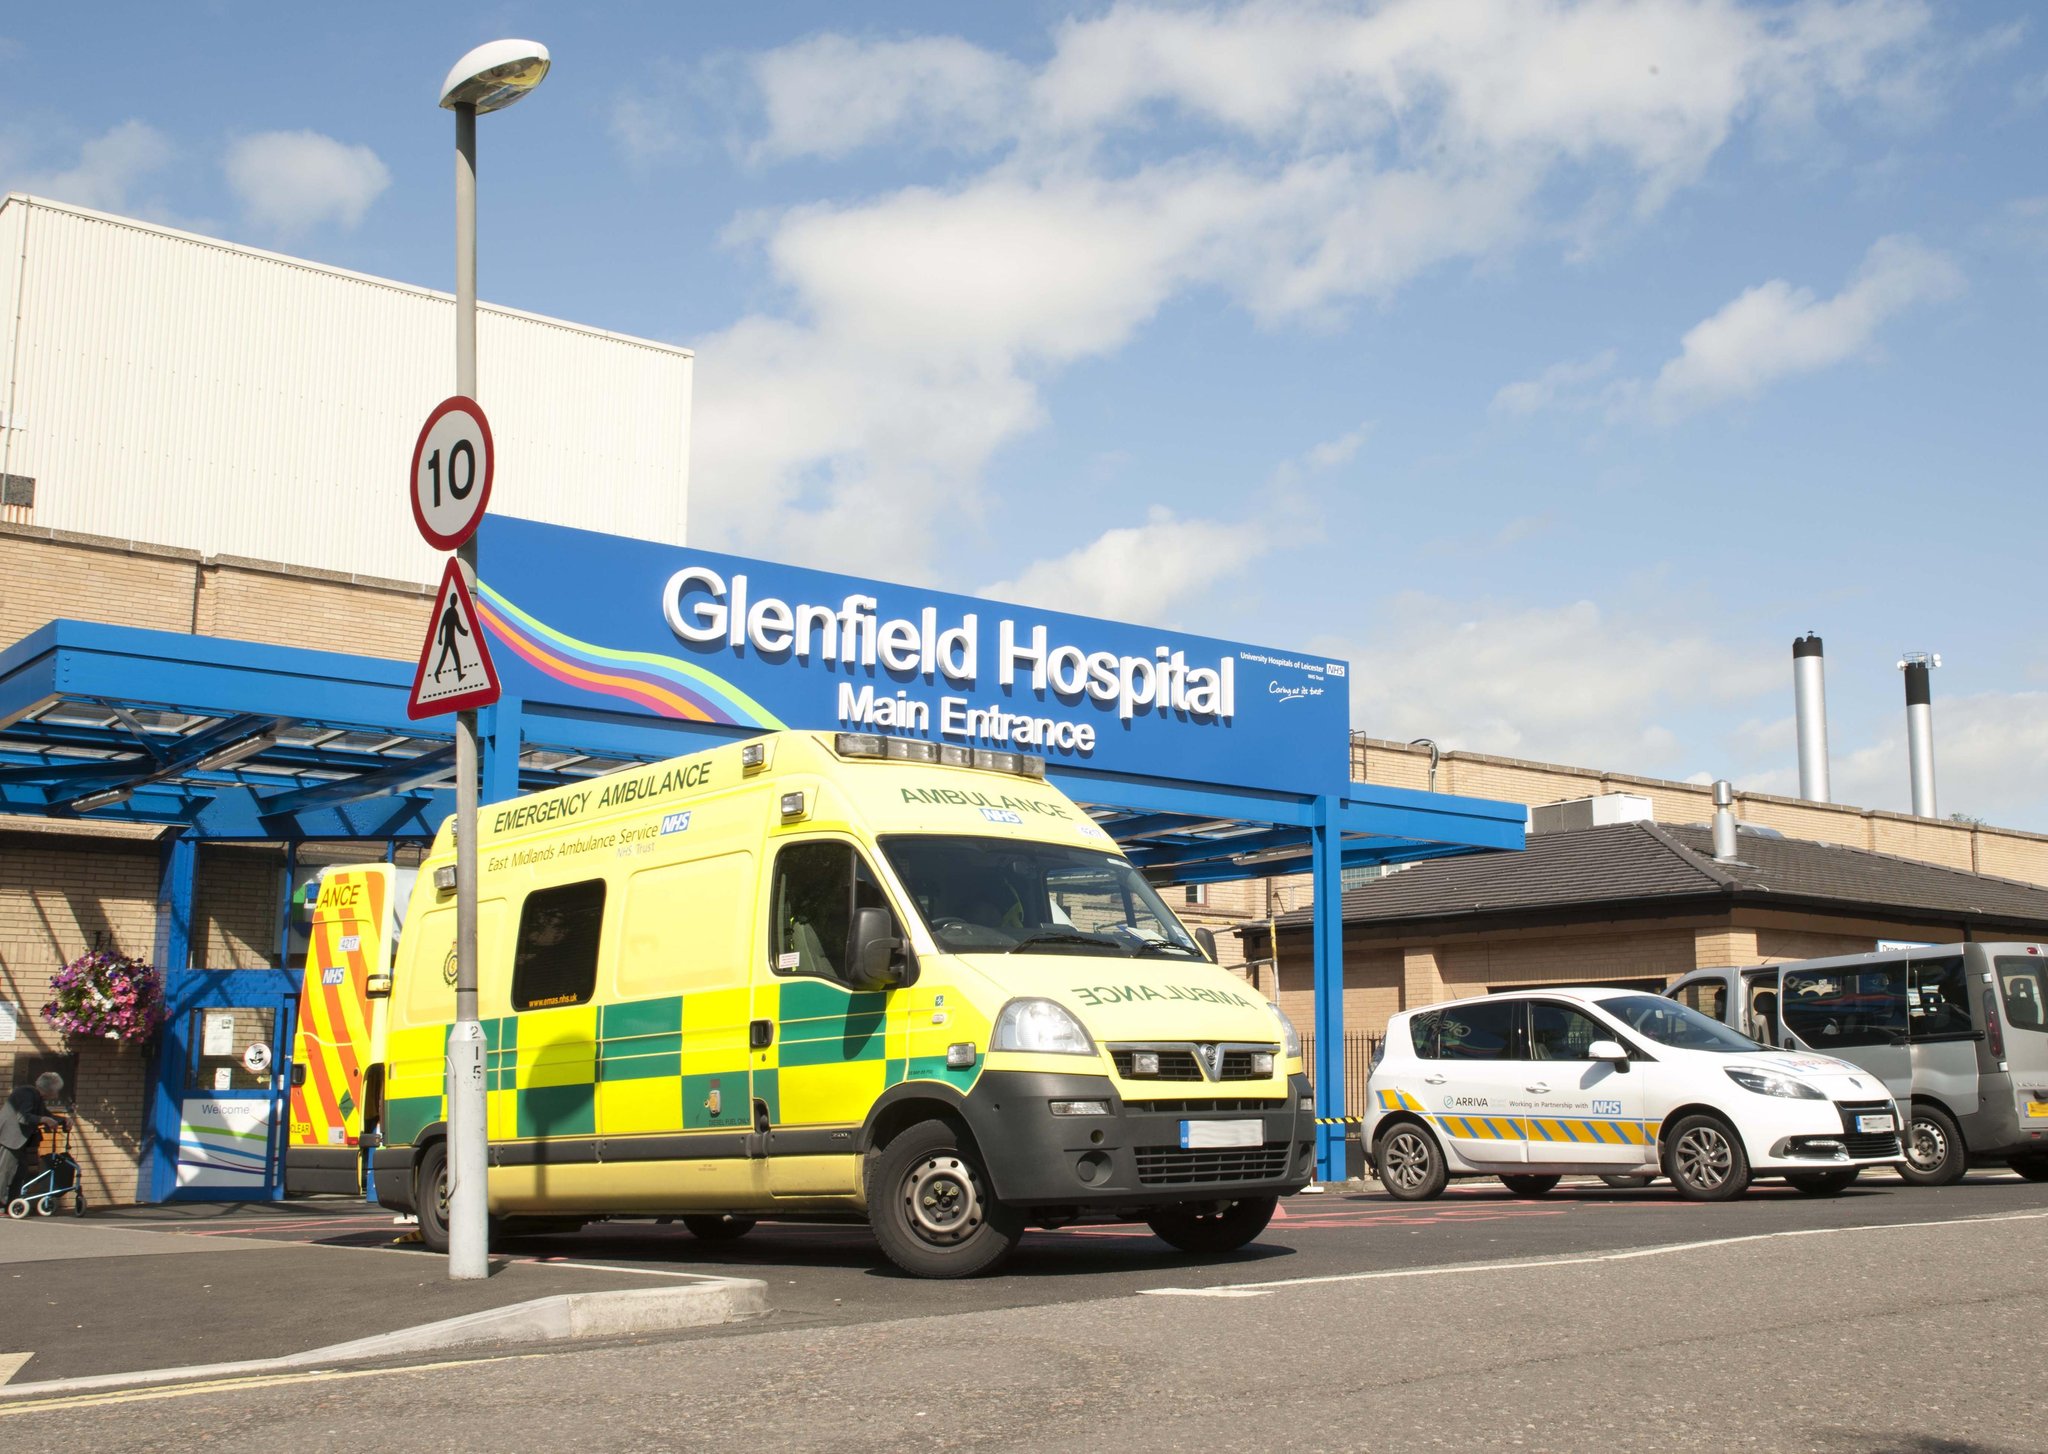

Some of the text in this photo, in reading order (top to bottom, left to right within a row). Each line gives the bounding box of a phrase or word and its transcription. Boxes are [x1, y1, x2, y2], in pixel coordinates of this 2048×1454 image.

[428, 438, 476, 508] 10
[662, 566, 1235, 720] Glenfield Hospital
[1240, 652, 1267, 664] University
[1268, 657, 1293, 668] Hospitals
[1301, 662, 1324, 673] Leicester
[1327, 664, 1344, 676] NHS
[1269, 680, 1292, 697] Caring
[838, 682, 1096, 751] Main Entrance
[494, 761, 713, 833] EMERGENCY AMBULANCE
[900, 788, 1074, 821] AMBULANCE
[661, 812, 690, 834] NHS
[982, 808, 1022, 824] NHS
[488, 824, 659, 872] East Midlands Ambulance Service
[616, 842, 656, 858] NHS Trust
[316, 885, 361, 908] ANCE
[323, 968, 344, 984] NHS
[528, 993, 577, 1007] www.emas.nhs.uk
[202, 1104, 250, 1114] Welcome
[1455, 1097, 1489, 1107] ARRIVA
[1509, 1101, 1533, 1109] Working
[1541, 1102, 1573, 1110] Partnership
[1593, 1101, 1620, 1114] NHS
